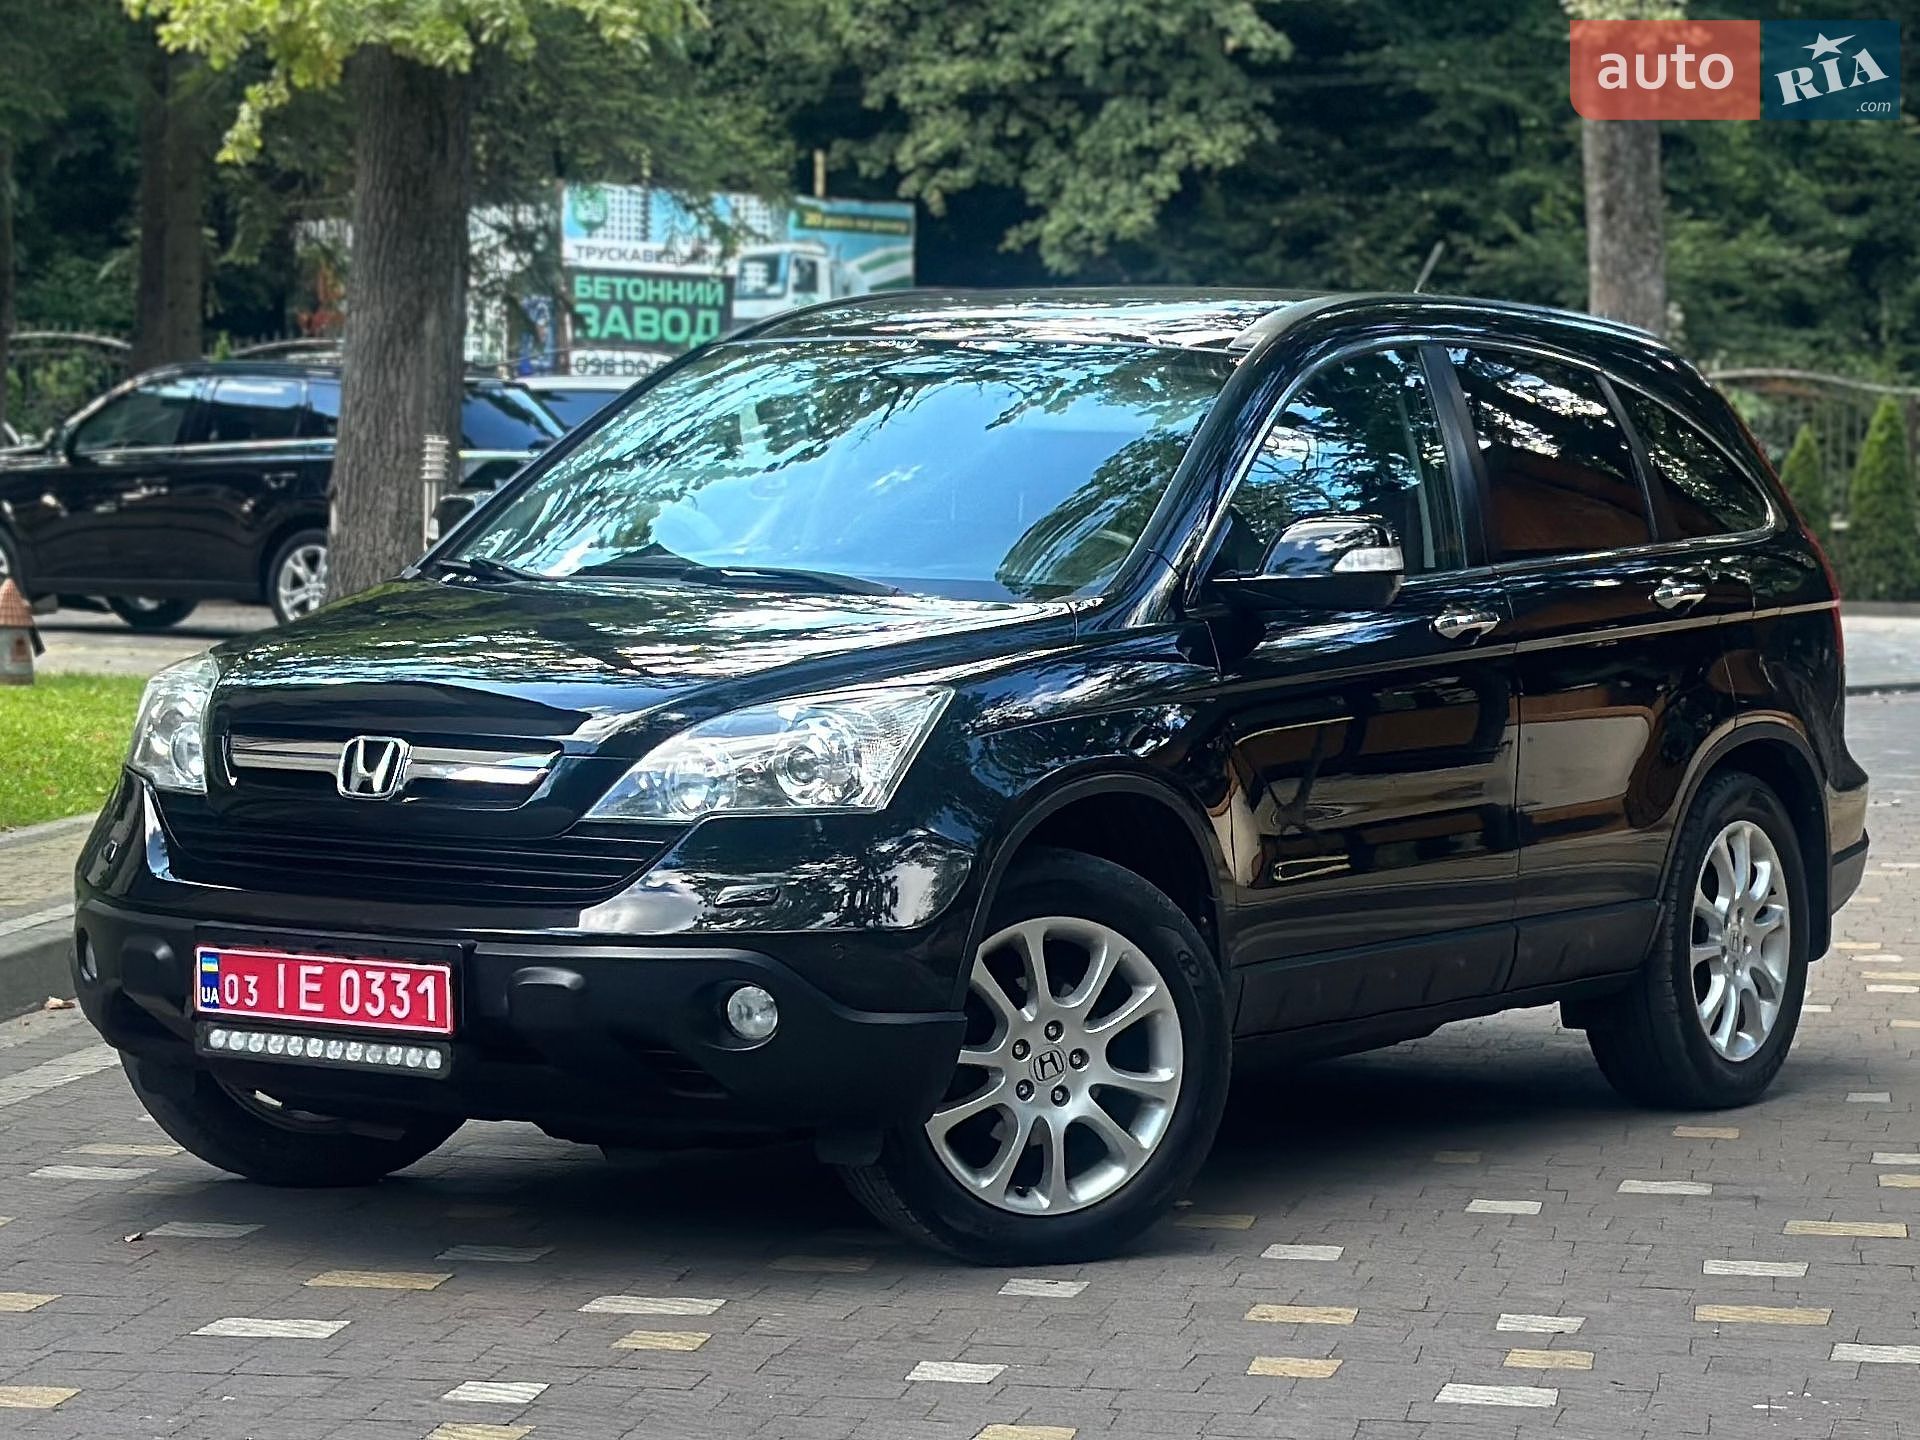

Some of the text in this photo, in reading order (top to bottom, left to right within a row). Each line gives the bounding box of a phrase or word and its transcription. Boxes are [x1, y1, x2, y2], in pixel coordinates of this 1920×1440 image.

[574, 274, 725, 306] БЕТОННИЙ
[574, 303, 720, 349] ЗАВОД
[201, 986, 220, 1005] UA
[224, 973, 259, 1007] 03
[339, 968, 437, 1022] 0331
